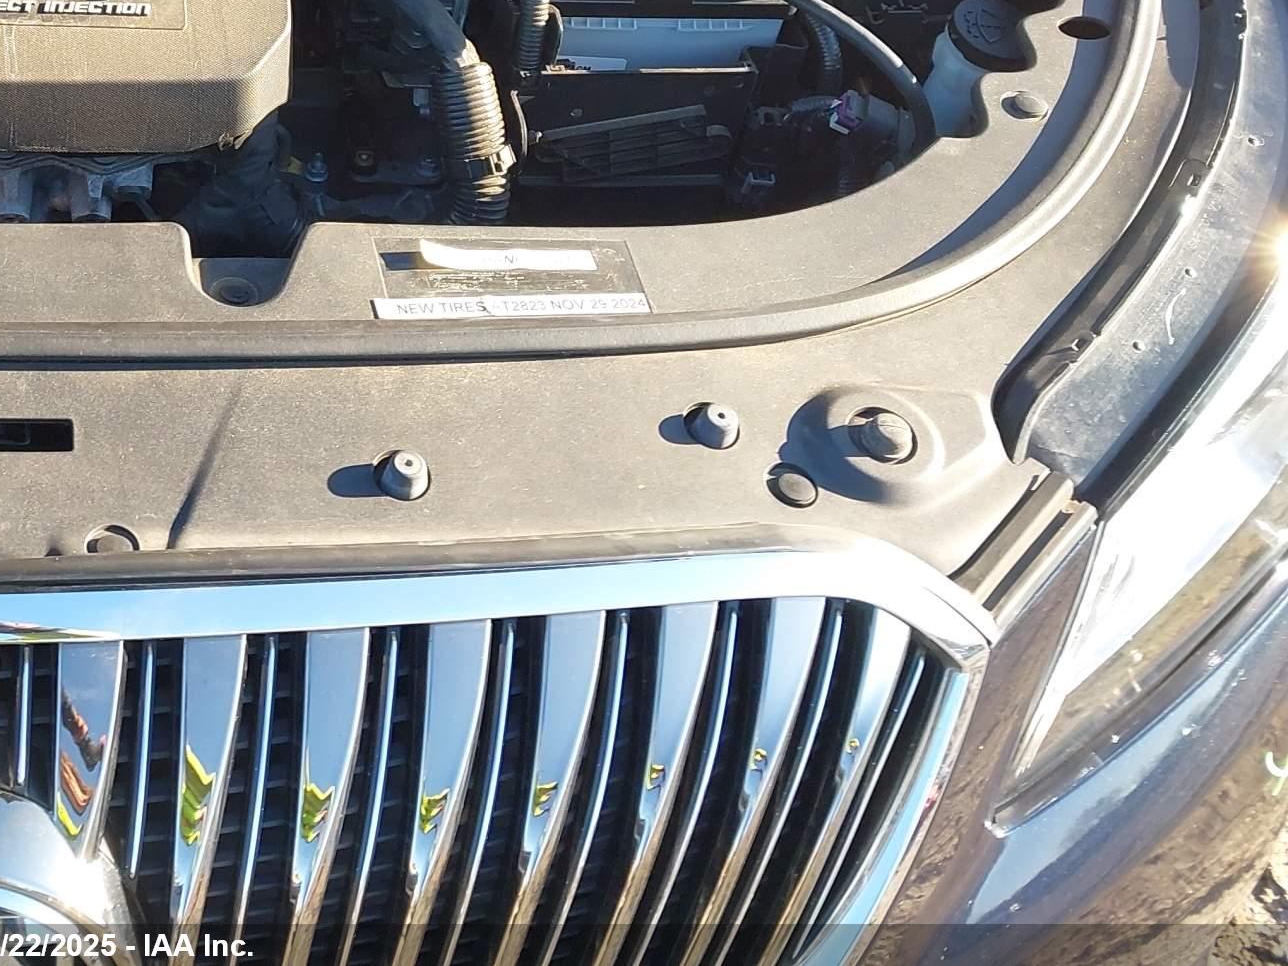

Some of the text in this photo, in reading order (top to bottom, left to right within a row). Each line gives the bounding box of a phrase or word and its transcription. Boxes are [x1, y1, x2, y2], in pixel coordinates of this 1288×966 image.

[37, 0, 152, 16] INJECTION
[396, 303, 434, 315] NEW
[439, 301, 487, 313] TIRES
[550, 299, 584, 310] NOV
[612, 296, 646, 309] 2024
